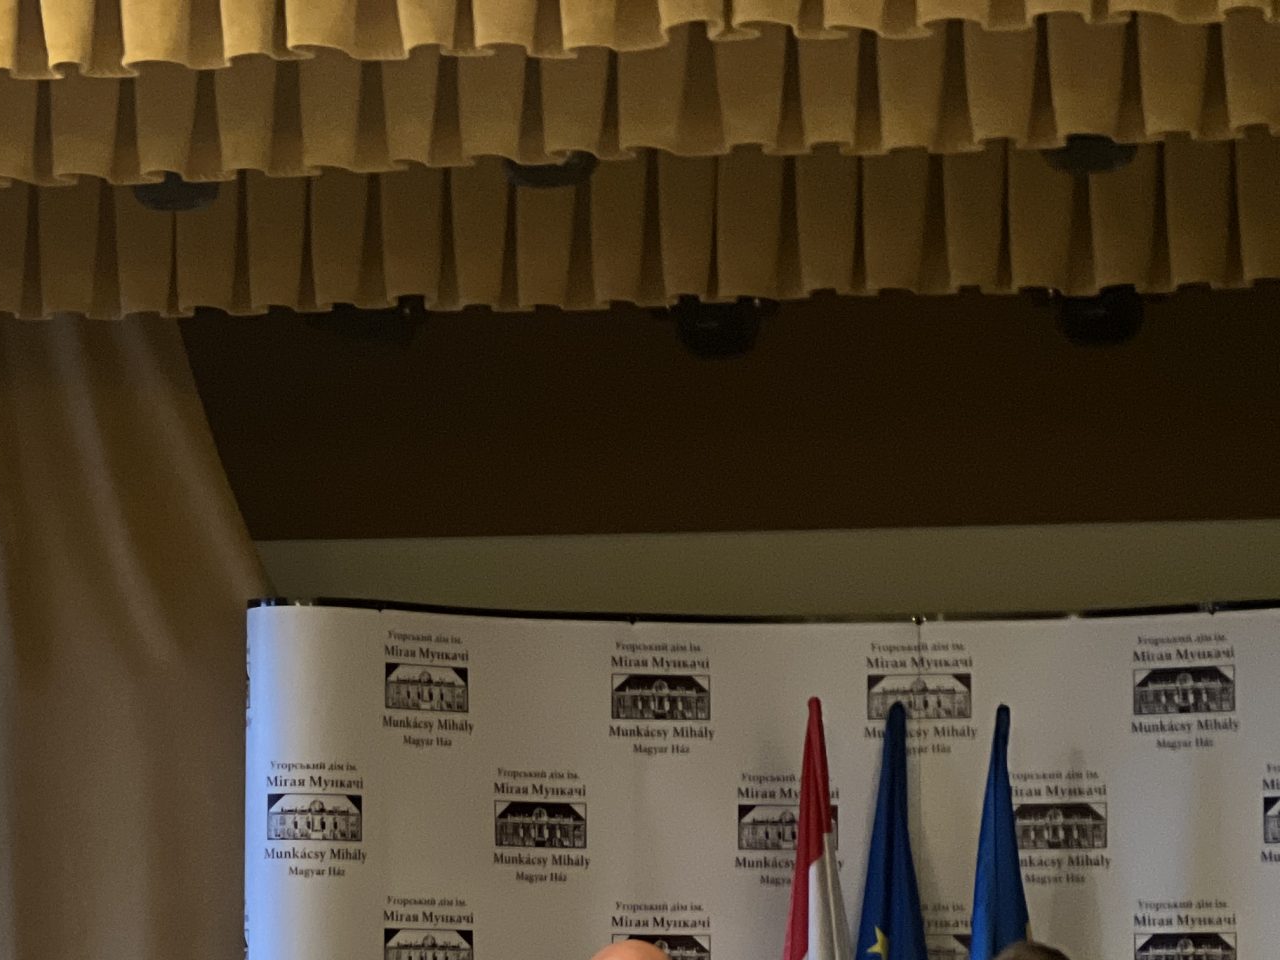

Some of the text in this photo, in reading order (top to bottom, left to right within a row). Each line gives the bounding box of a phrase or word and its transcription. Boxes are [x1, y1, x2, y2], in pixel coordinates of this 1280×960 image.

[384, 645, 468, 663] Мігая Мункачі
[1133, 646, 1234, 661] Мігая Мункачі
[611, 656, 710, 670] Мігая Мункачі
[867, 656, 971, 670] Мігая Мункачі
[383, 716, 474, 736] Munkácsy Mihály
[608, 726, 714, 740] Munkácsy Mihály
[934, 726, 977, 740] Mihály
[1132, 718, 1240, 734] Munkácsy Mihály
[1012, 770, 1063, 781] горський
[267, 776, 364, 791] Мігая Мункачі
[494, 782, 586, 798] Мігая Мункачі
[738, 787, 776, 799] Мігая
[1012, 784, 1107, 798] ігая Мункачі
[264, 847, 367, 863] Munkácsy Mihály
[494, 854, 591, 870] Munkácsy Mihály
[1020, 855, 1112, 868] nkácsy Mihály
[384, 910, 474, 925] Мігая Мункачі
[612, 916, 710, 930] Мігая Мункачі
[1134, 914, 1236, 928] Мігая Мункачі
